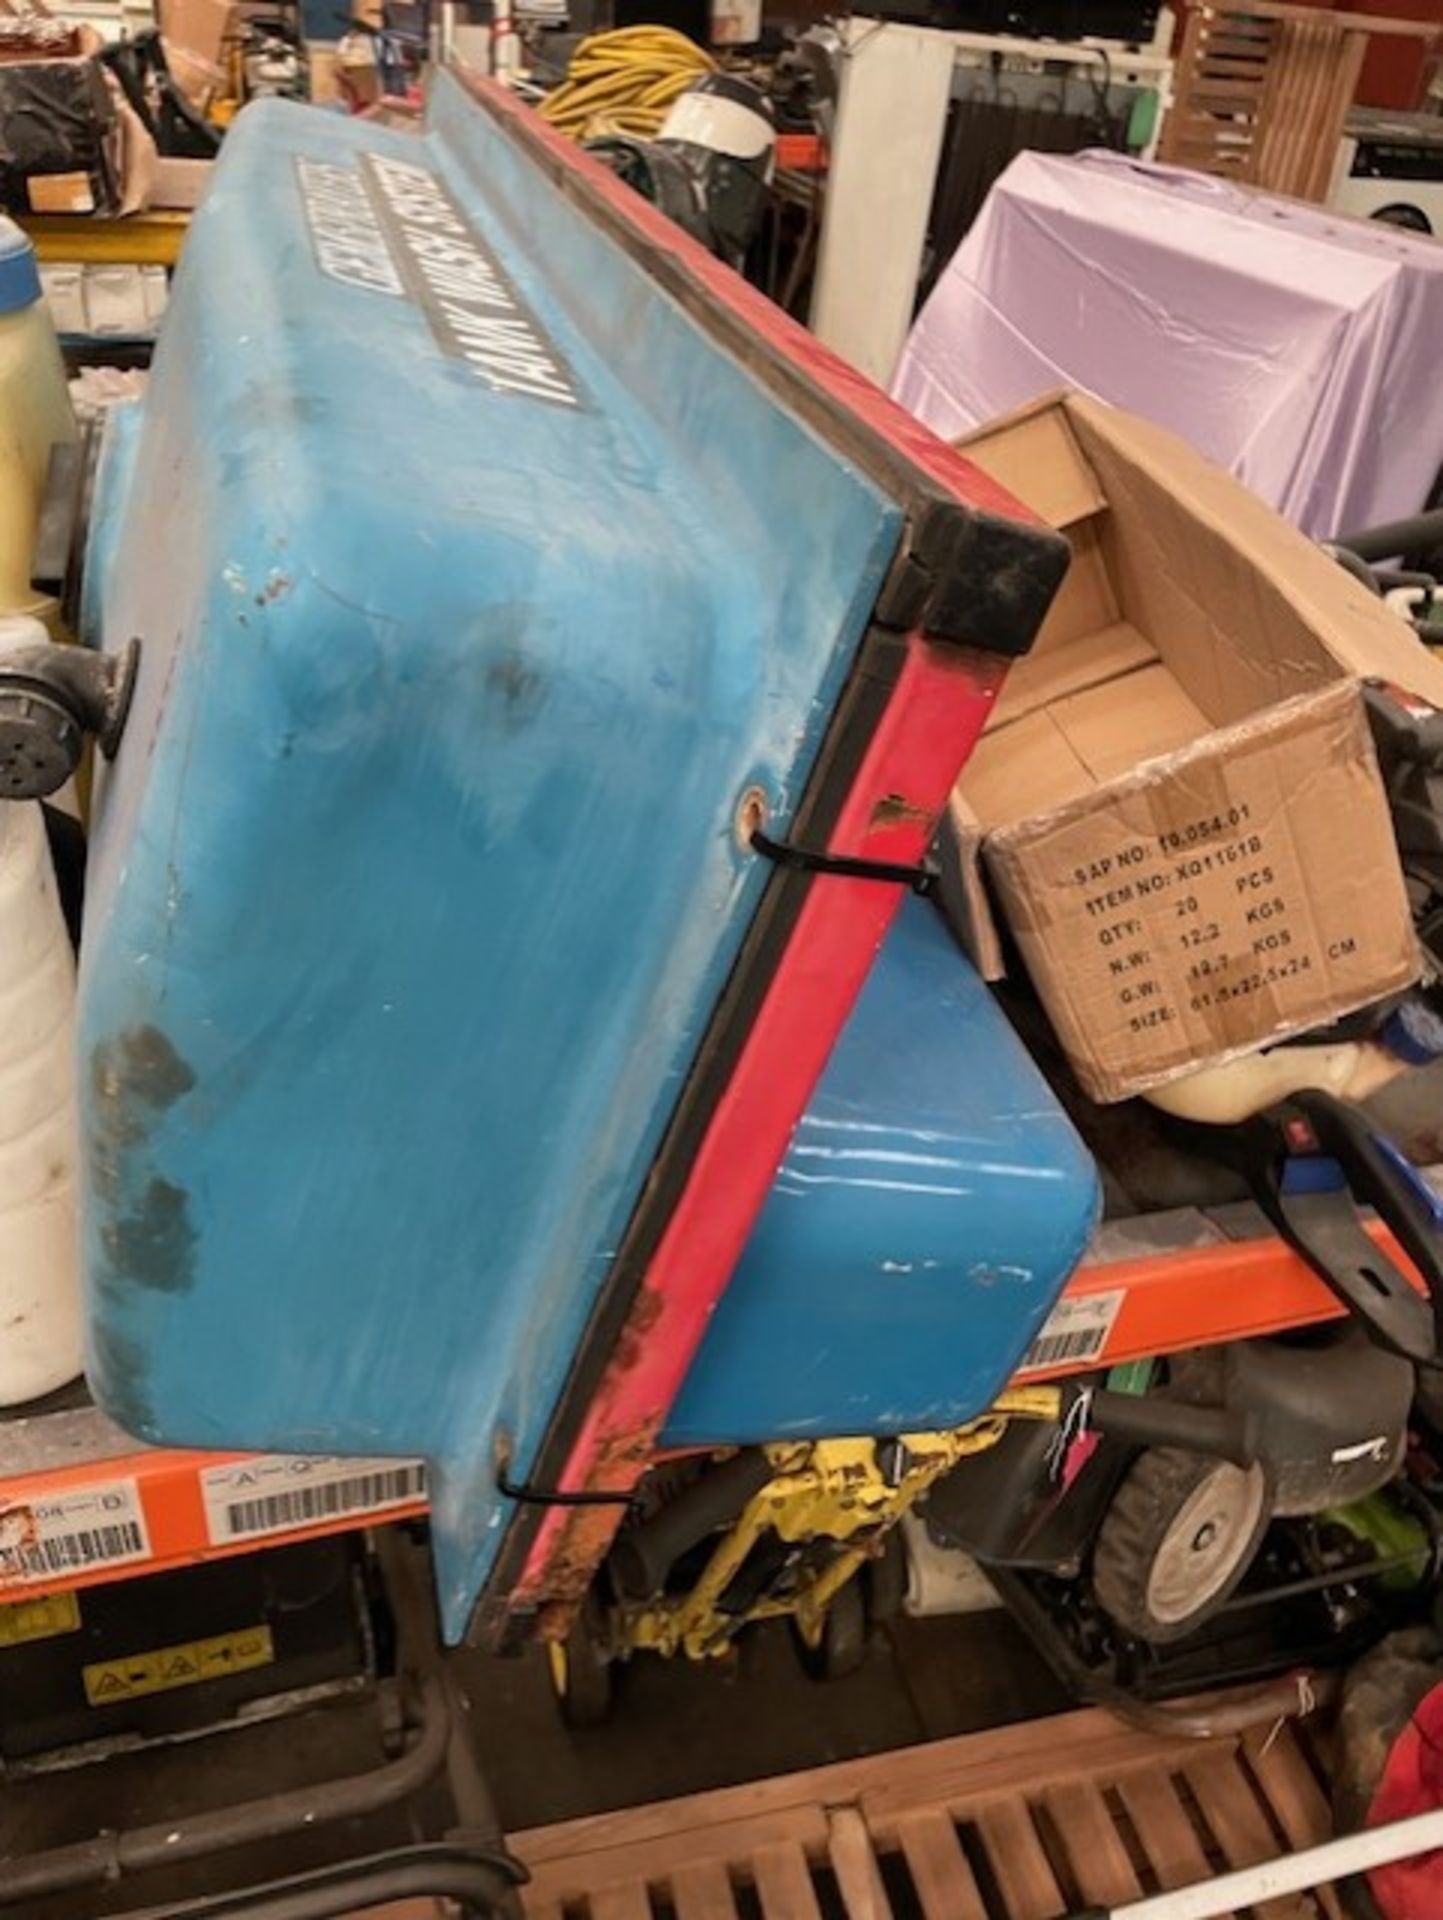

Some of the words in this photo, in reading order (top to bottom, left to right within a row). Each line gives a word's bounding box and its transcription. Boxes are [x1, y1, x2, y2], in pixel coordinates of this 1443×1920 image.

[401, 223, 517, 311] WASH
[441, 299, 578, 403] TANK
[1074, 857, 1113, 886] SAP
[1085, 885, 1134, 917] ITEM
[1136, 873, 1171, 897] NO:
[1098, 919, 1142, 946] QTY:
[1176, 896, 1199, 916] 20
[1236, 866, 1274, 894] PCS
[1179, 922, 1221, 949] 12.2
[1244, 897, 1286, 924] KGS
[1252, 929, 1292, 956] KGS
[1129, 1007, 1176, 1032] SIZE:
[1327, 938, 1357, 961] CM
